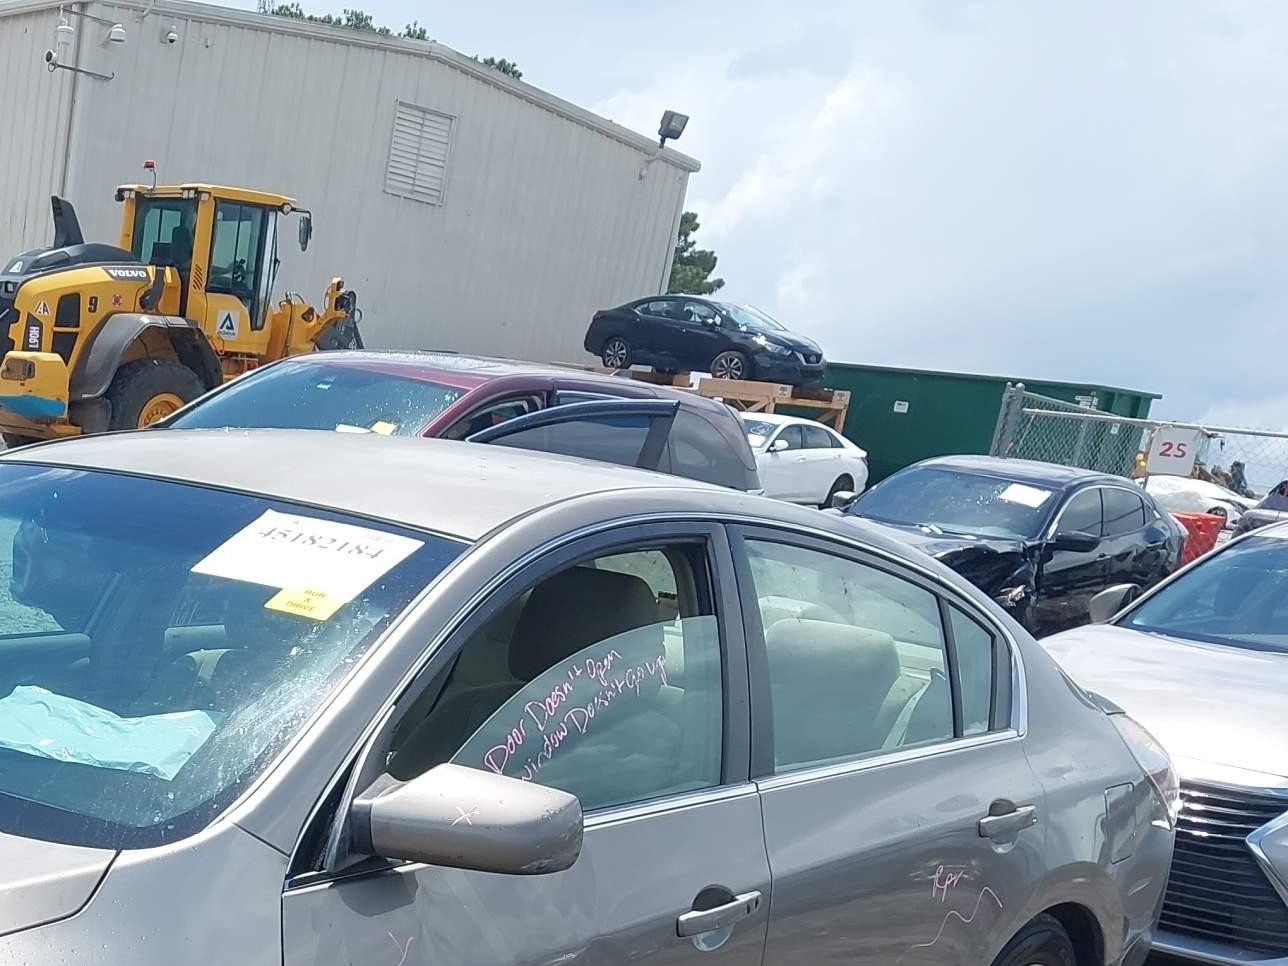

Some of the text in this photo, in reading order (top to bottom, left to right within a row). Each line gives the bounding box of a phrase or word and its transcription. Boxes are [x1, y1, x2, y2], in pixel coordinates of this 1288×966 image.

[108, 269, 147, 278] VOLVO
[88, 296, 98, 313] 9
[28, 326, 40, 349] L90H
[259, 527, 385, 557] 45182184
[304, 589, 327, 599] RUN
[286, 600, 317, 612] DRIVE
[484, 718, 526, 775] Door
[586, 650, 622, 687] Open
